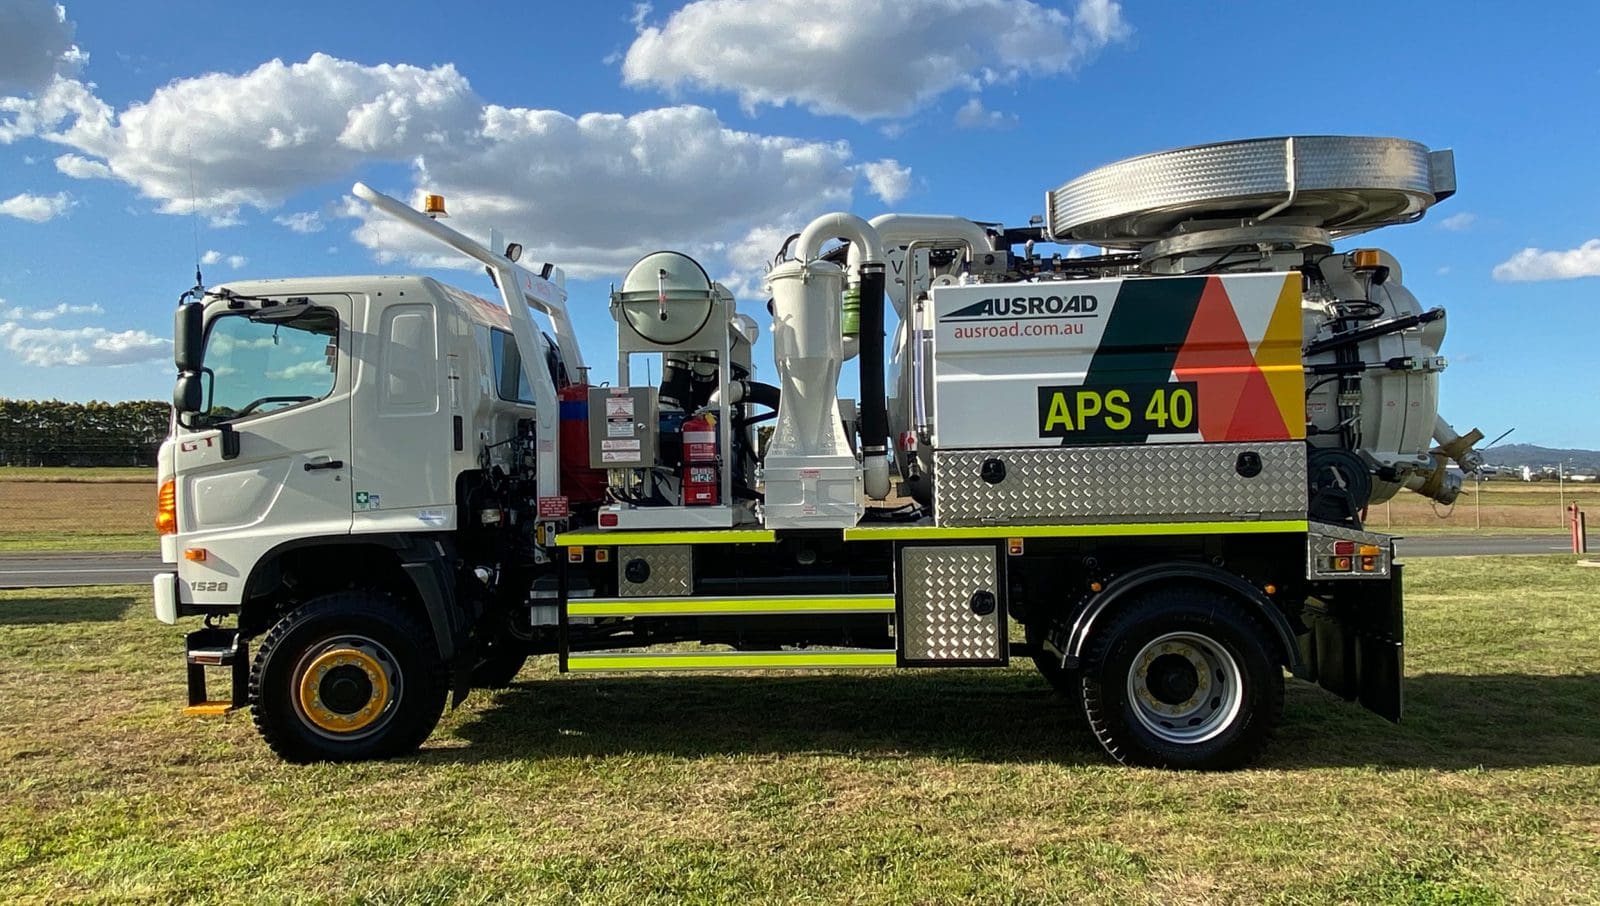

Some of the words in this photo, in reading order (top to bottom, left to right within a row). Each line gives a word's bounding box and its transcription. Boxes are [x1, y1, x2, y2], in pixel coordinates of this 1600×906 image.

[941, 295, 1098, 317] AUSROAD
[954, 322, 1084, 339] ausroad.com.au
[1044, 389, 1132, 431] APS
[1145, 389, 1193, 428] 40
[181, 436, 217, 453] GT
[191, 581, 229, 592] 1528
